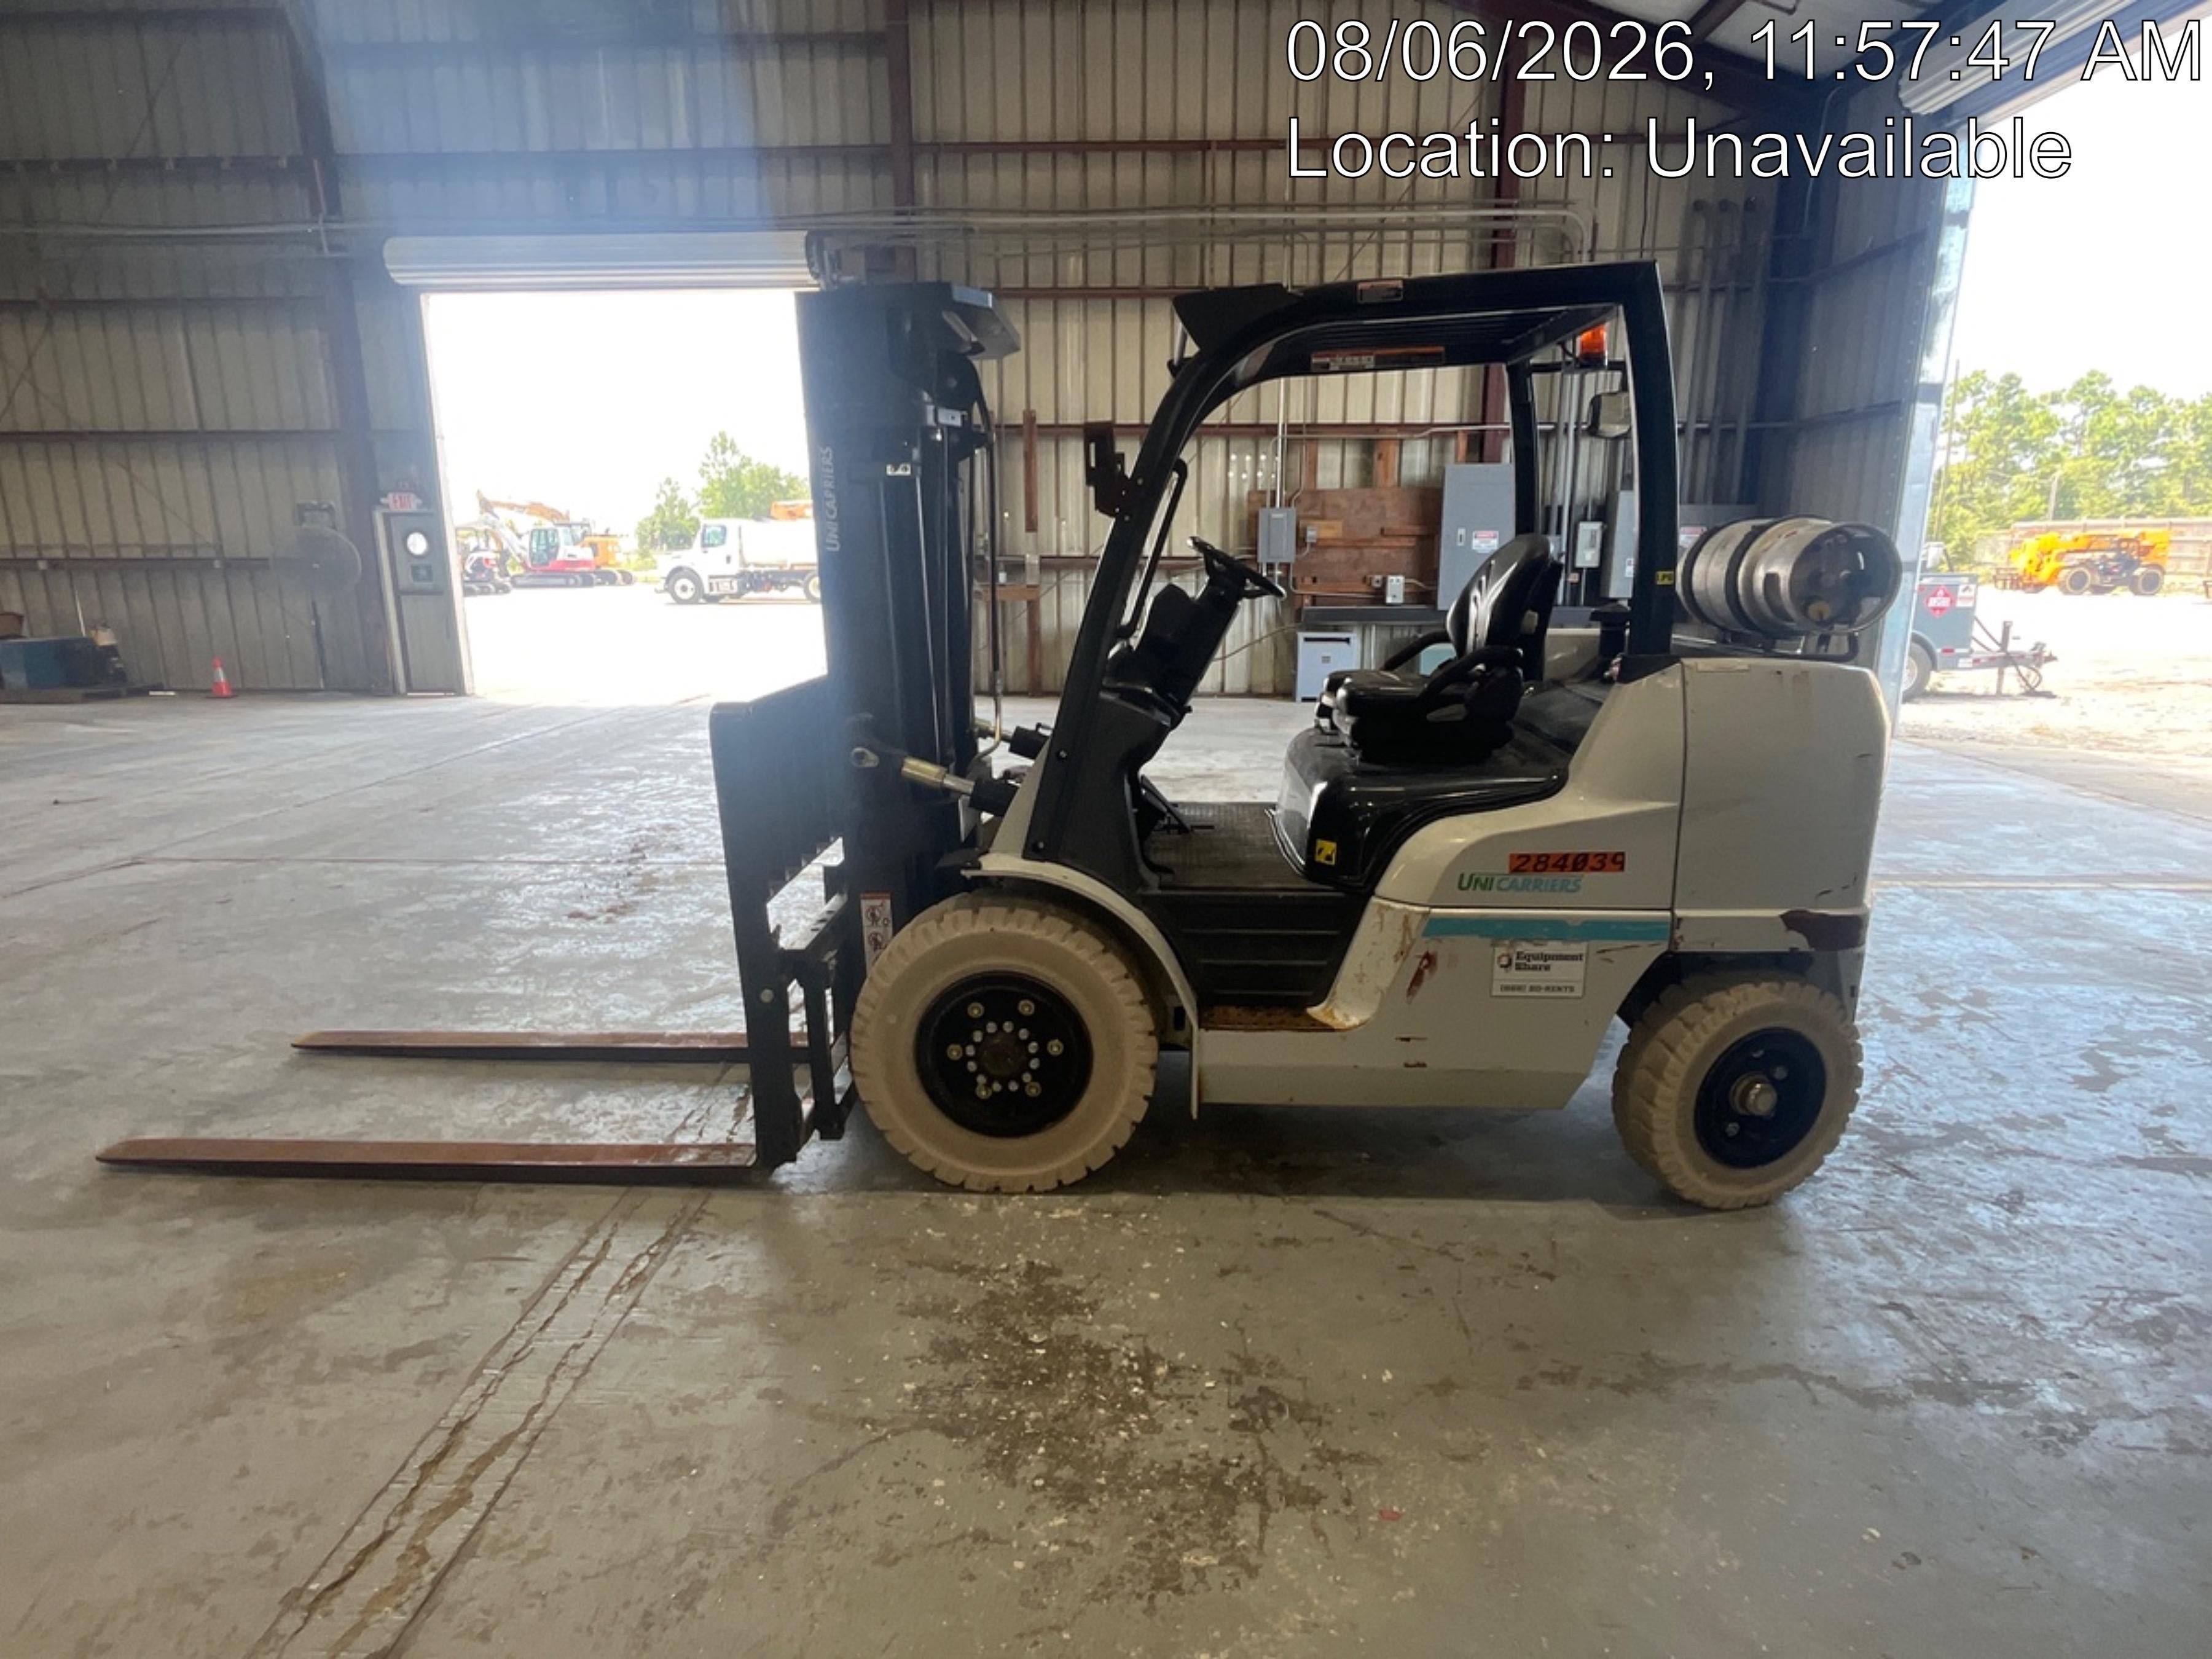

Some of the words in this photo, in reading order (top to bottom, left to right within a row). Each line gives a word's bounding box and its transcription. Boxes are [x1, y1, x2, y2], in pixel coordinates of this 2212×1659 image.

[1511, 852, 1626, 873] 284039
[1516, 951, 1583, 962] Equipment
[1515, 962, 1551, 971] Share
